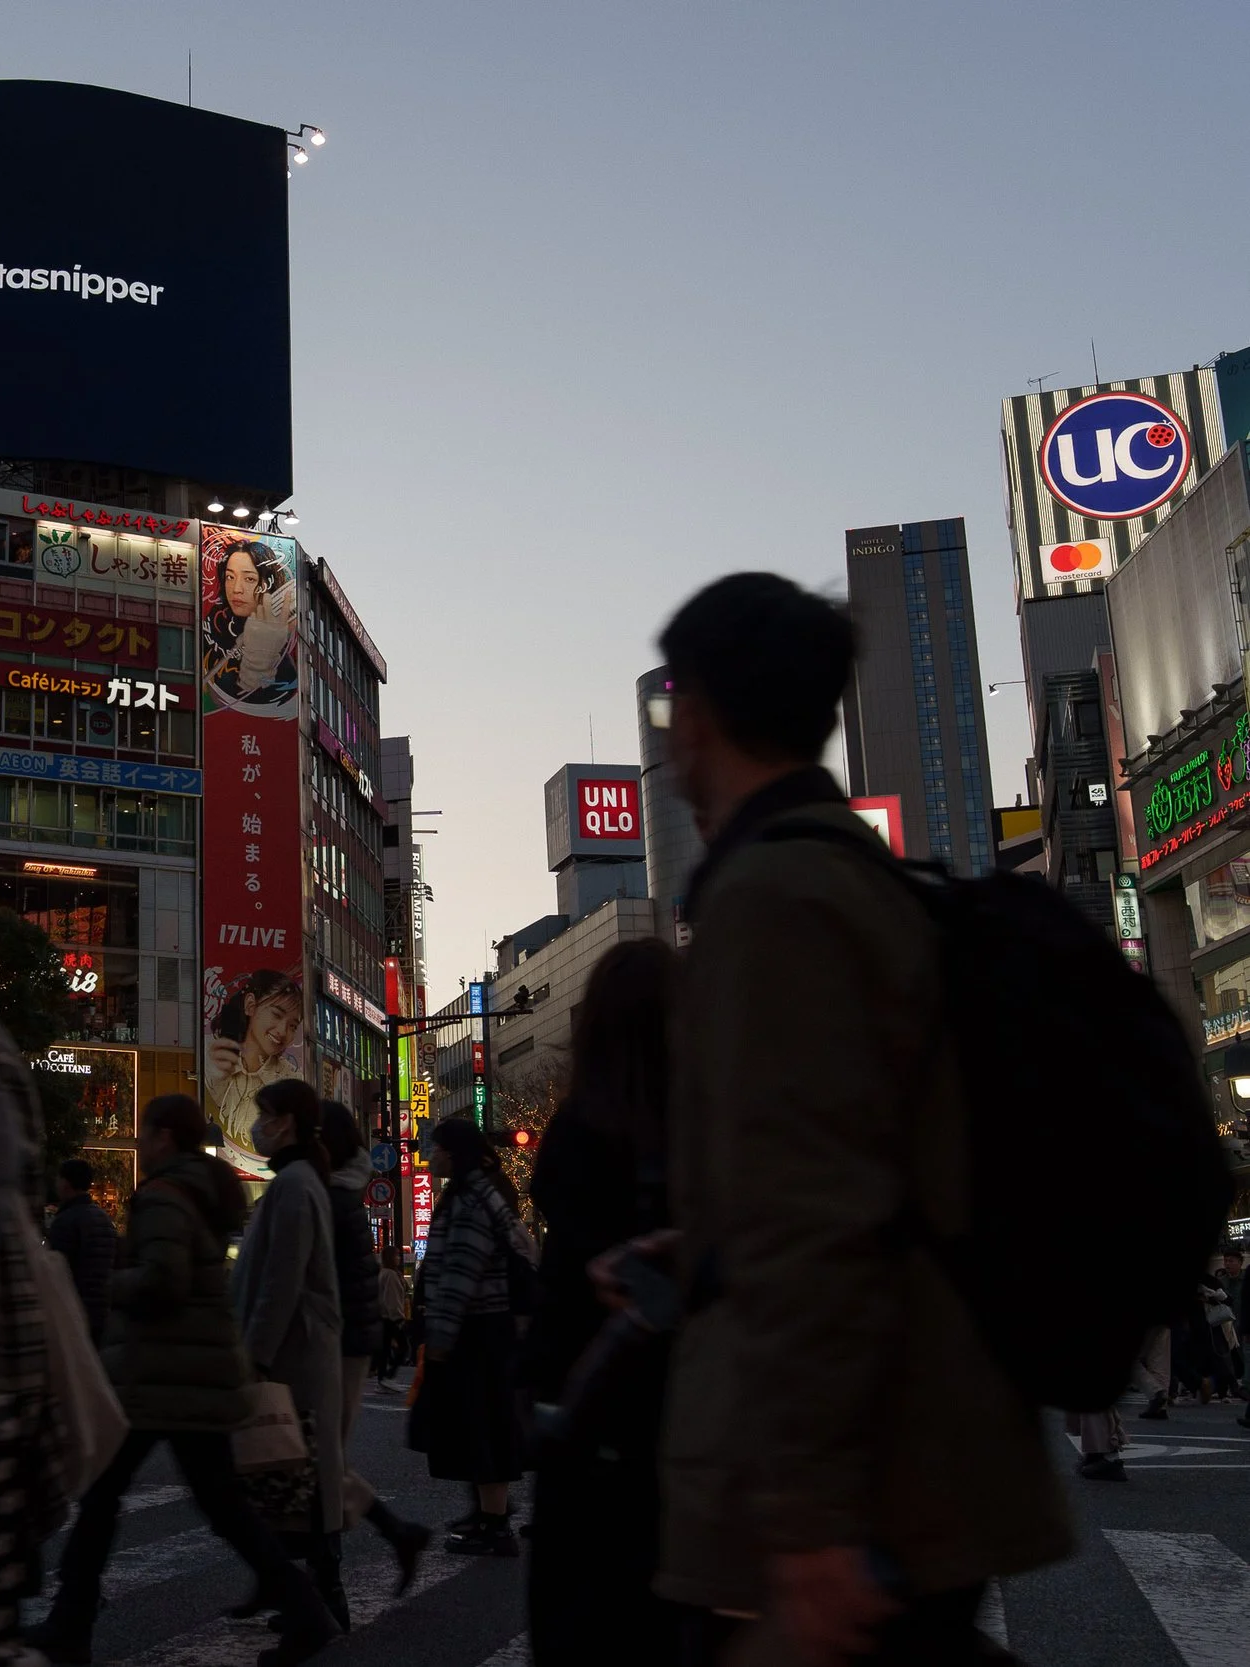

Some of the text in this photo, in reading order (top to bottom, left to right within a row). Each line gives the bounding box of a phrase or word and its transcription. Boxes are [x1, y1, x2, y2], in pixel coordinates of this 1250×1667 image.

[1056, 421, 1175, 487] UC
[22, 495, 190, 538] しゃぶしゃぶバイキング
[852, 544, 895, 556] INDIGO
[861, 538, 885, 546] HOTEL
[91, 543, 188, 586] しゃぶ葉
[1054, 569, 1102, 581] mastercard
[7, 668, 180, 712] Caféレストラン ガスト
[0, 753, 47, 773] AEON
[58, 757, 198, 790] 英会話イーオン
[584, 786, 628, 808] UNI
[1172, 766, 1213, 823] 西村
[241, 734, 263, 910] 私が、始まる。
[585, 810, 633, 836] QLO
[413, 878, 423, 940] CAMERA
[218, 924, 287, 949] 17LIVE
[413, 1174, 432, 1238] スギ薬局
